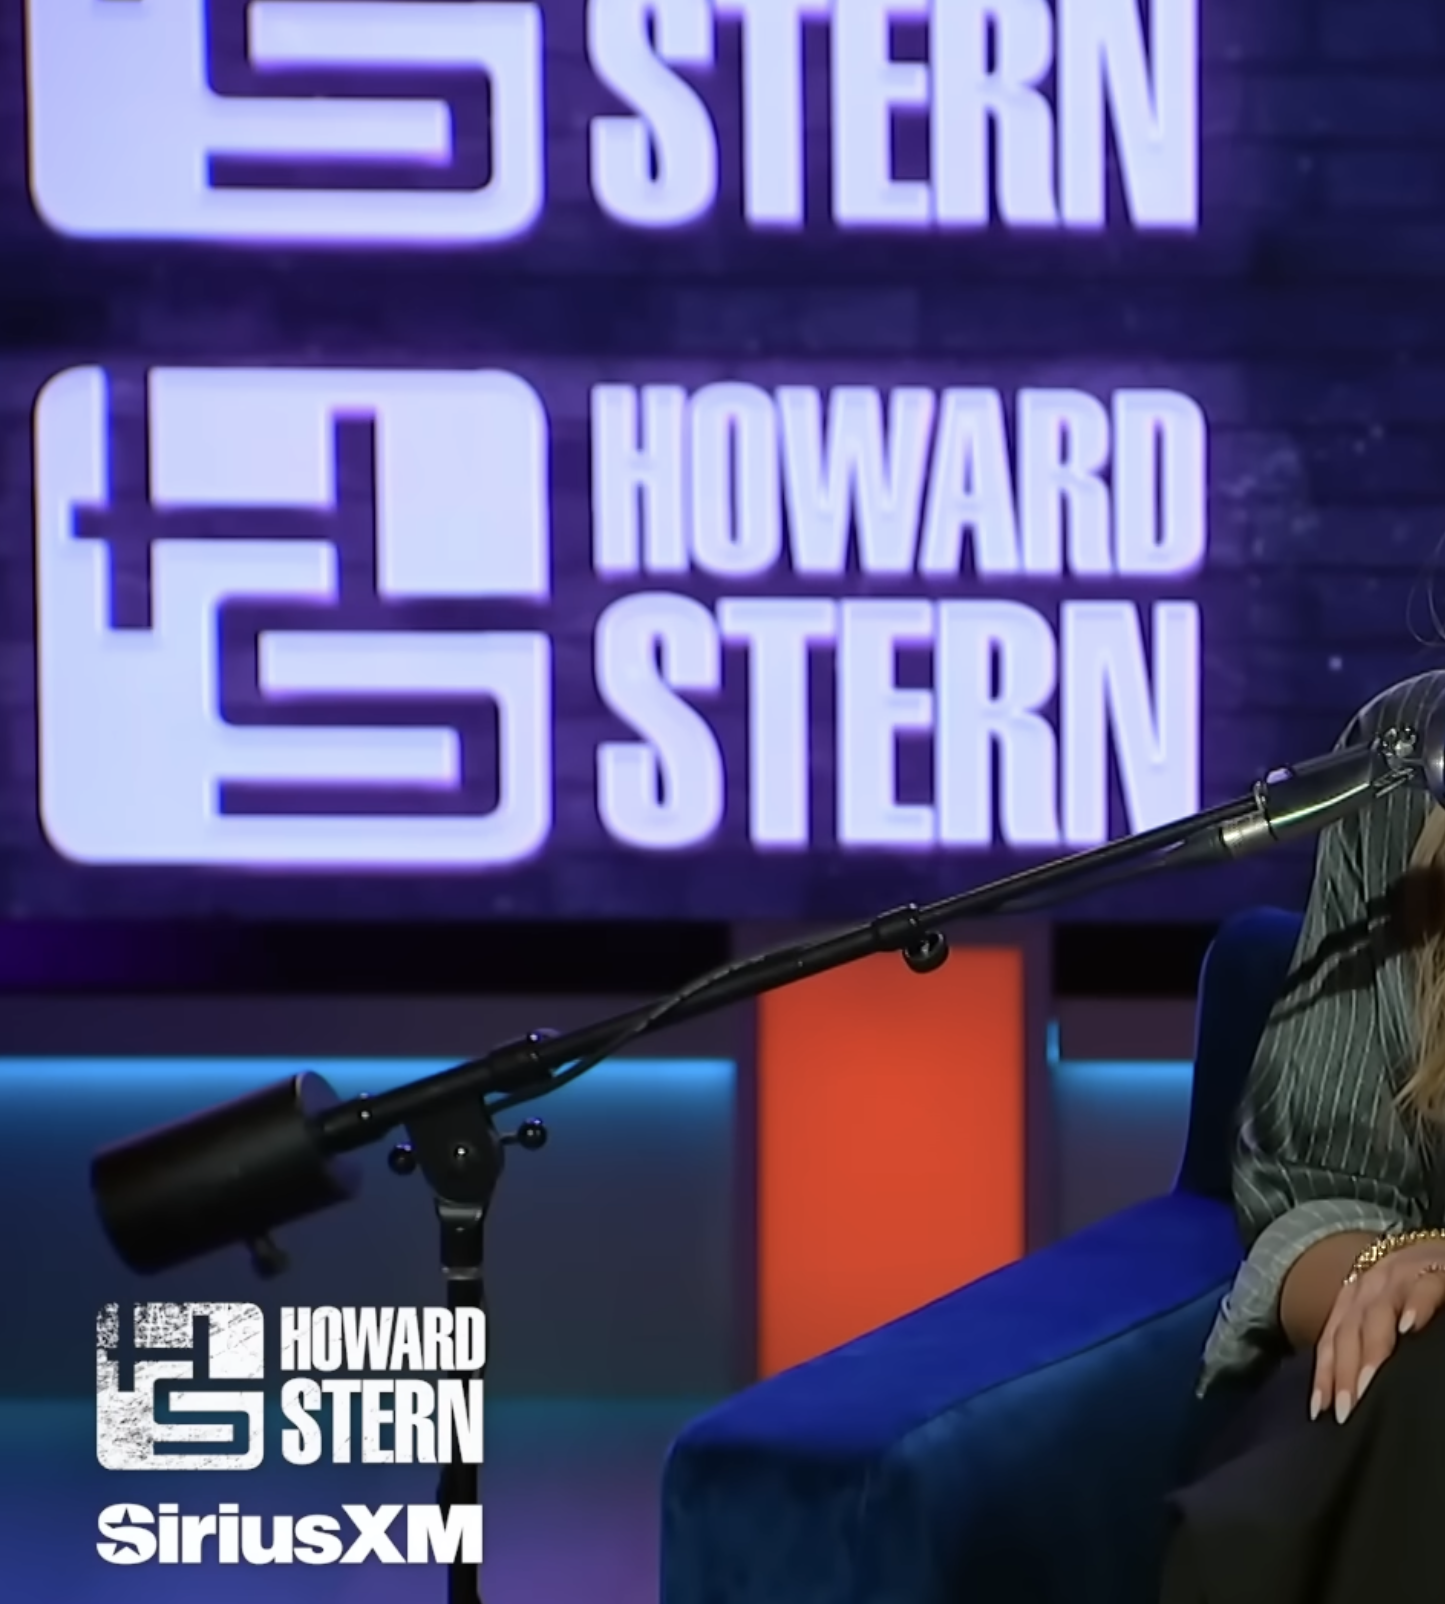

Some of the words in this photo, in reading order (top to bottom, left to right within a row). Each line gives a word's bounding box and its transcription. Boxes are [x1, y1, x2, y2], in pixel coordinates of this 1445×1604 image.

[588, 0, 1198, 229] STERN
[591, 381, 1207, 577] HOWARD
[595, 591, 1200, 850] STERN
